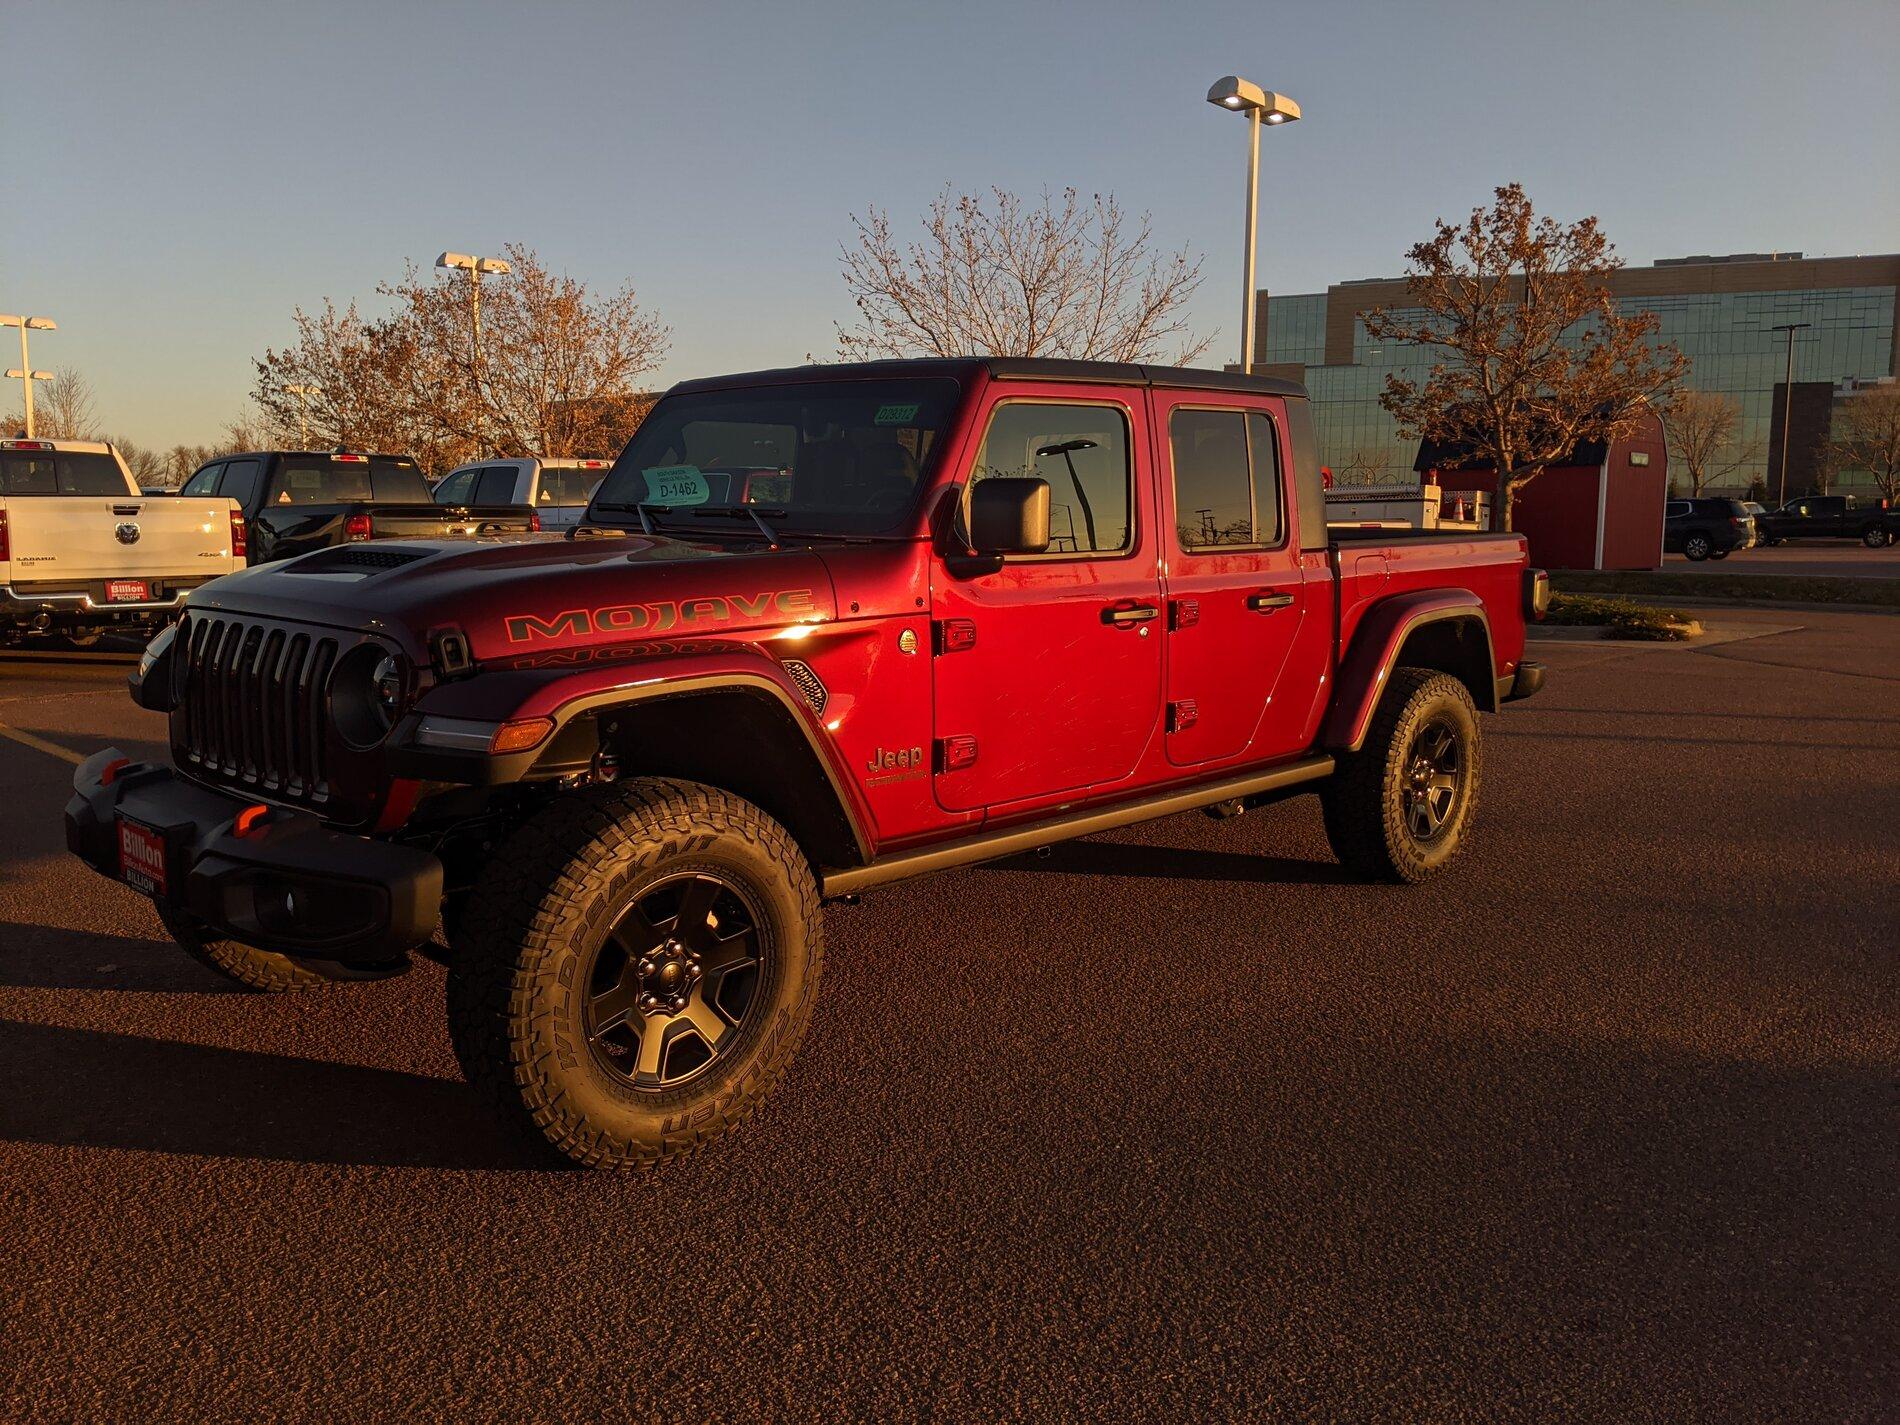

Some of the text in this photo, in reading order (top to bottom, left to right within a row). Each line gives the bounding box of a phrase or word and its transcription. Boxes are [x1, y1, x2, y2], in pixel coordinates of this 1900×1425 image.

[660, 482, 698, 497] D-1462
[111, 585, 144, 594] Billion
[504, 588, 816, 643] MOJAVE
[867, 747, 922, 773] Jeep
[122, 827, 163, 870] Billion
[126, 867, 154, 893] BILLION
